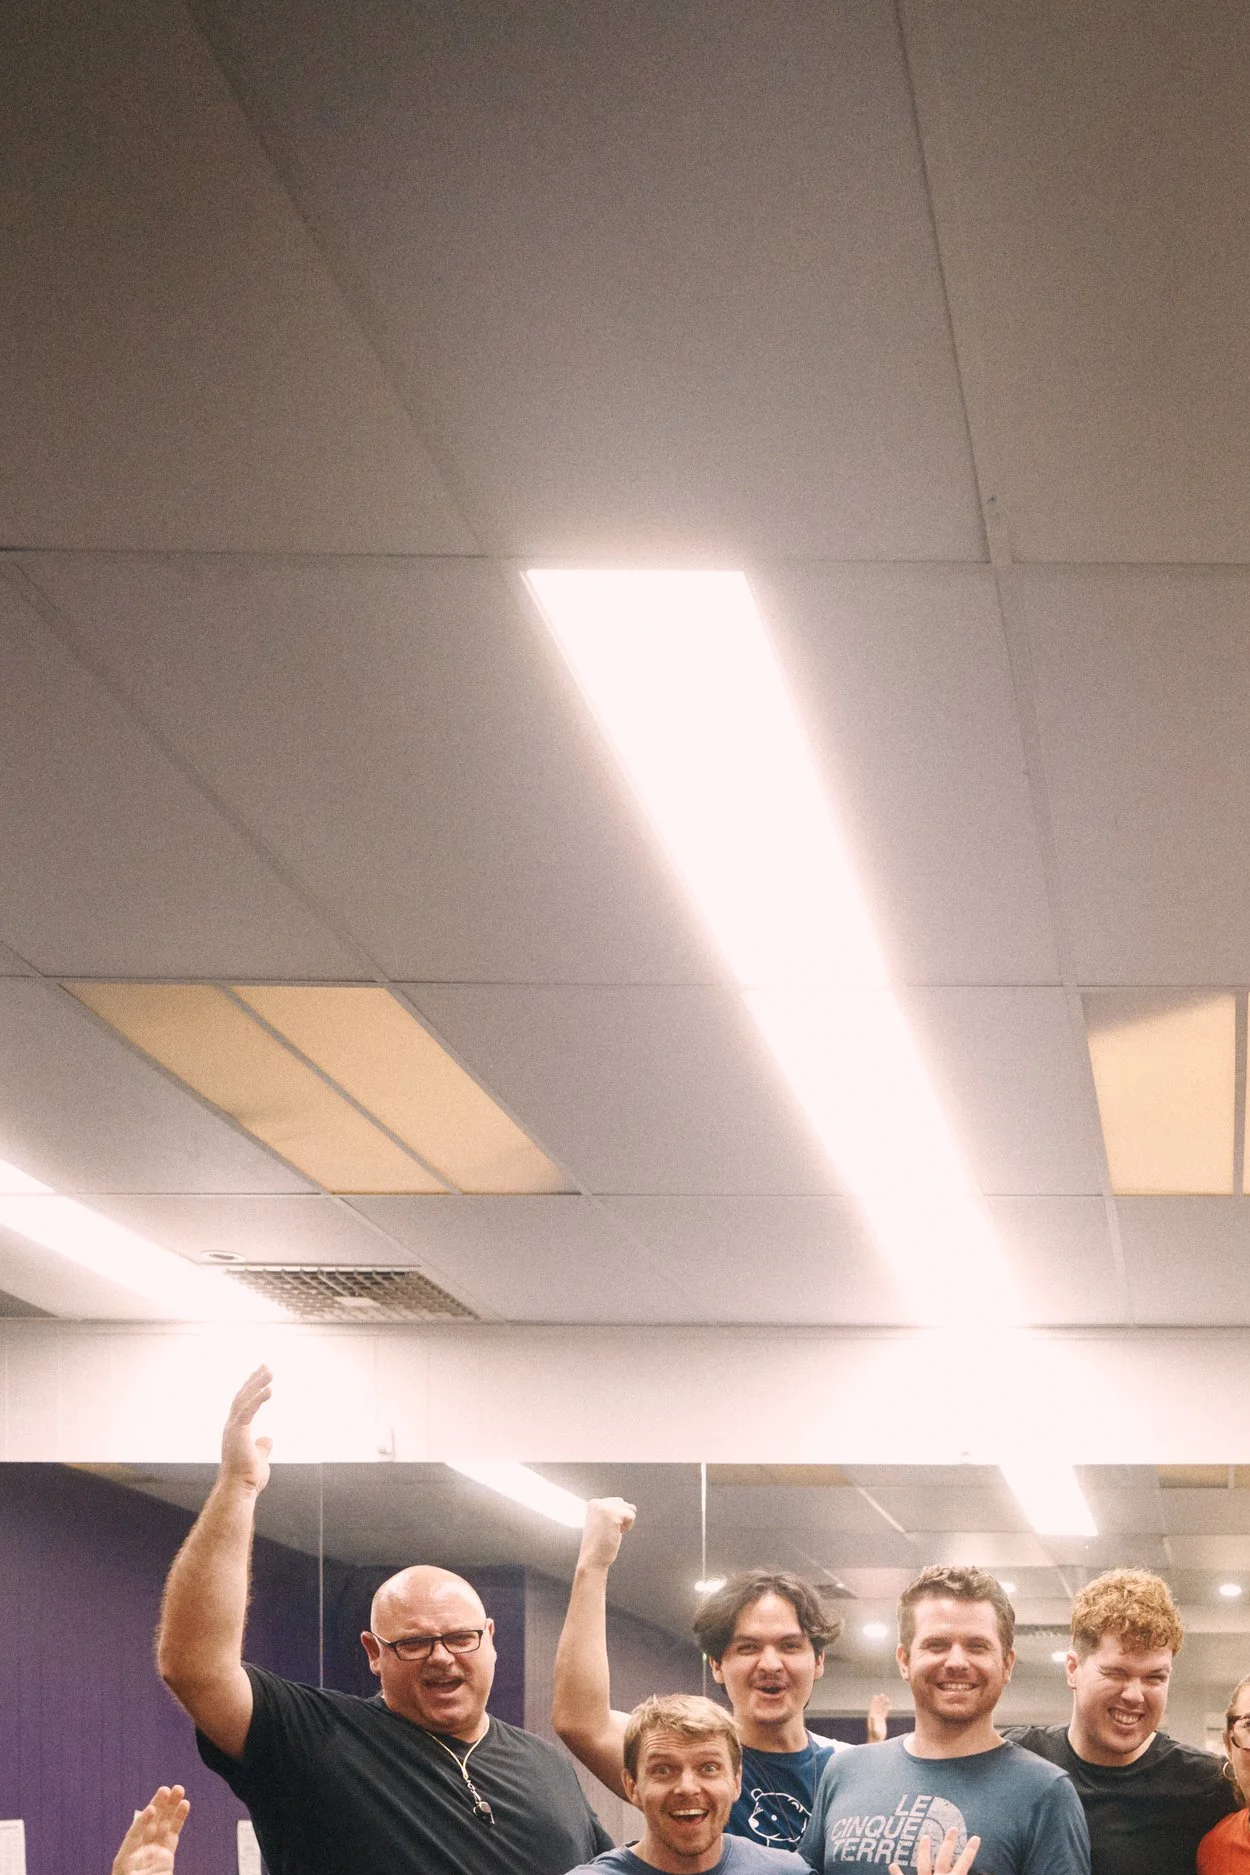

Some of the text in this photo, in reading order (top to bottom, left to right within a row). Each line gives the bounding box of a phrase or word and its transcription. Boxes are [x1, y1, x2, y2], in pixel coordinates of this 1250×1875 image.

[895, 1794, 934, 1817] LE
[831, 1815, 923, 1840] CINQUE
[832, 1838, 912, 1866] TERRE
